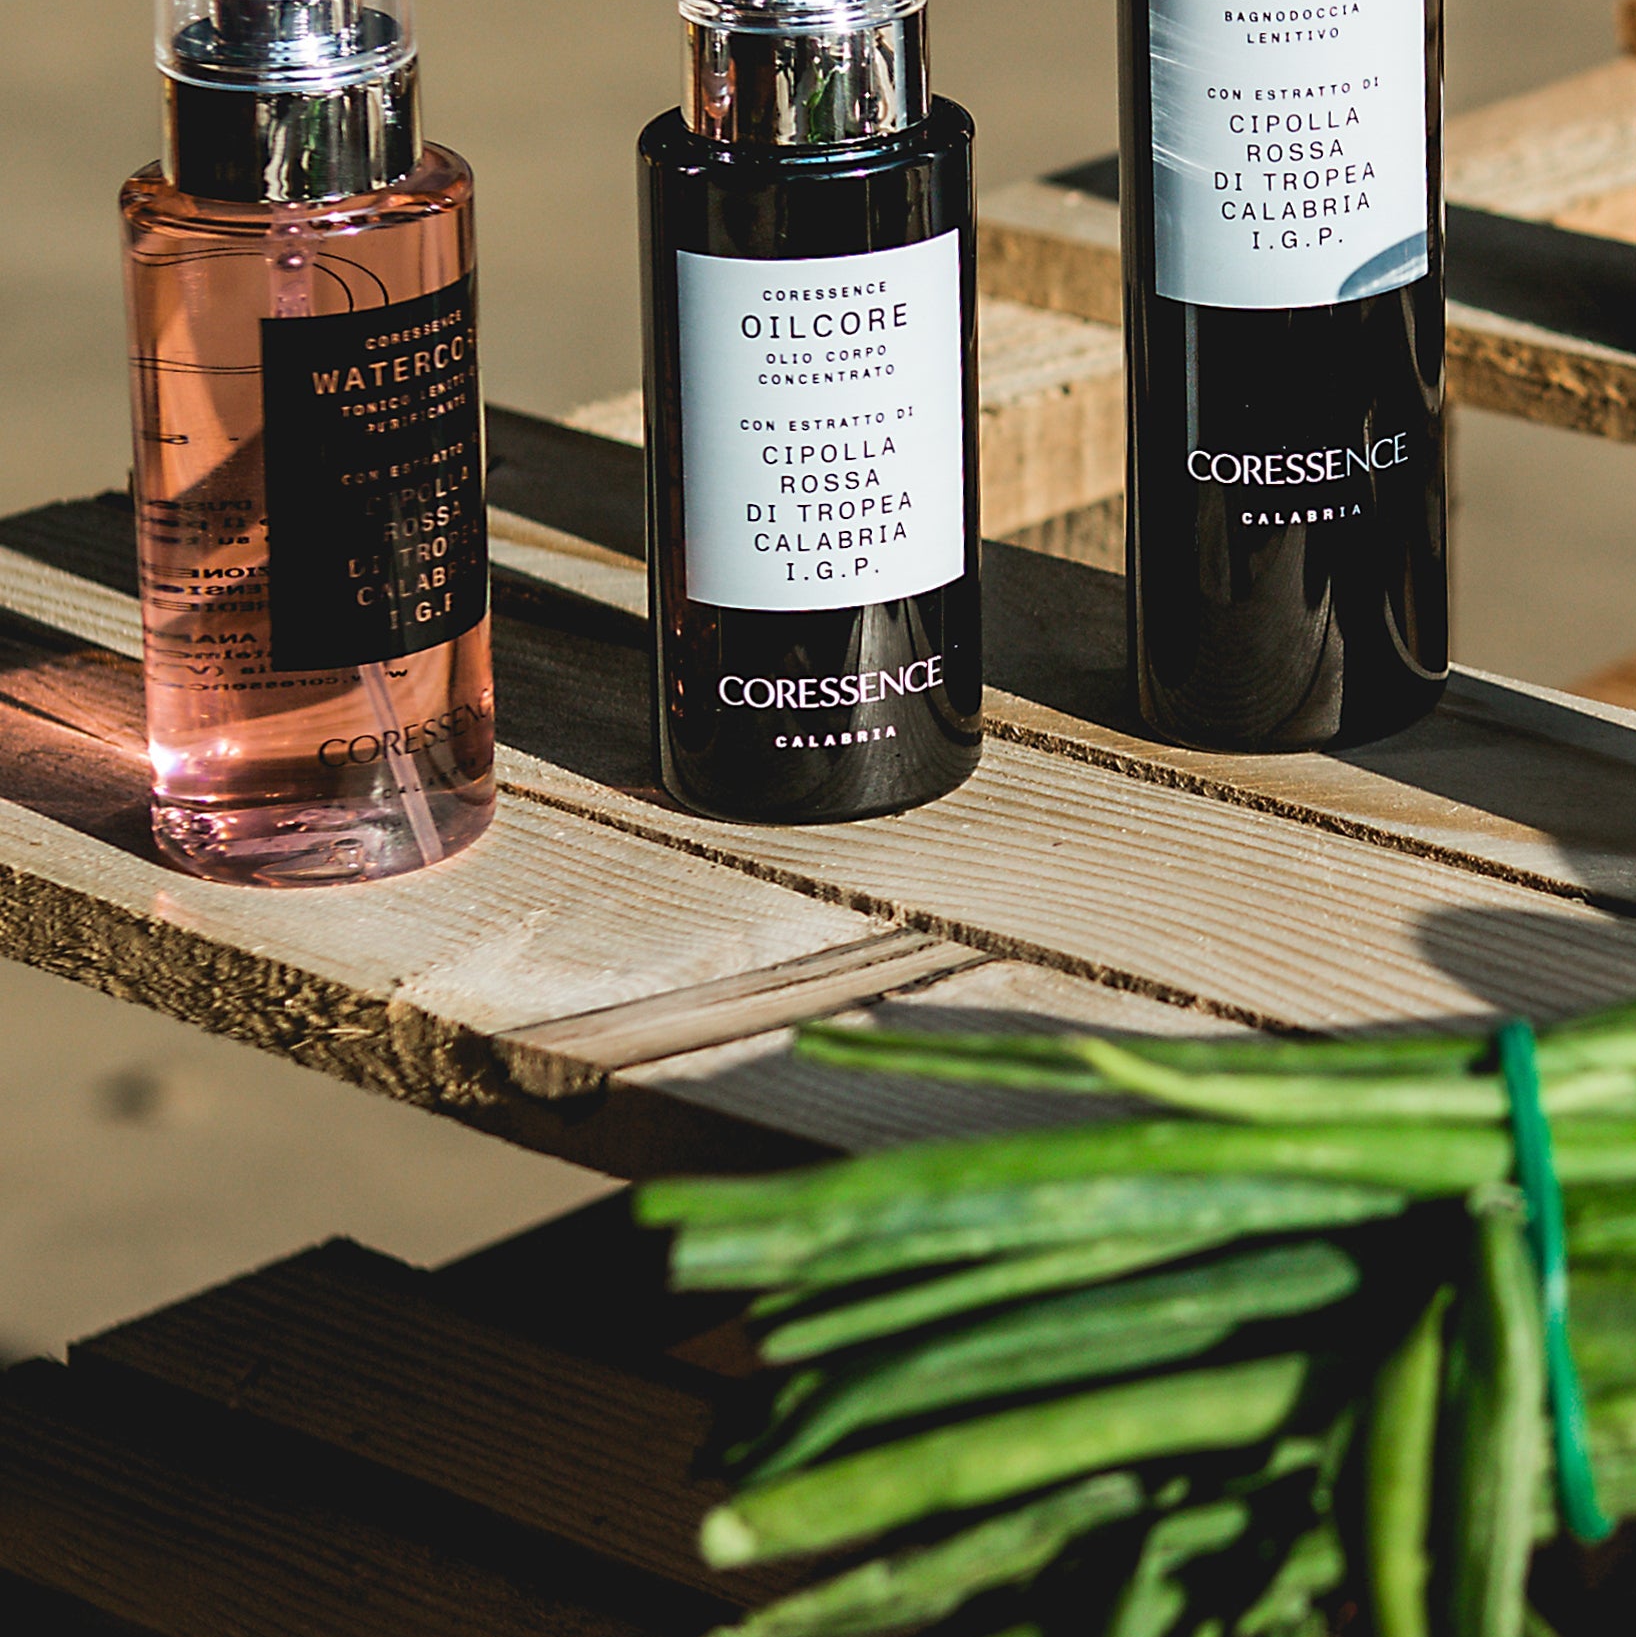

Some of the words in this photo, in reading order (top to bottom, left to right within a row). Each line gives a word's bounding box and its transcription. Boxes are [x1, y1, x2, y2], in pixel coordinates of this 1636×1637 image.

[1224, 3, 1360, 23] BAGNODOCCIA
[1247, 27, 1340, 45] LENITIVO
[1207, 87, 1242, 101] CON
[1255, 81, 1352, 101] ESTRATTO
[1363, 76, 1380, 90] DI
[1229, 107, 1360, 134] CIPOLLA
[1247, 139, 1344, 163] ROSSA
[1214, 172, 1243, 192] DI
[1263, 162, 1376, 192] TROPEA
[1221, 192, 1370, 221] CALABRIA
[1252, 227, 1344, 250] I.G.P.
[762, 281, 888, 302] CORESSENCE
[365, 309, 463, 350] CORESSENCE
[741, 302, 908, 340] OILCORE
[766, 352, 813, 365] OLIO
[826, 344, 888, 363] CORPO
[758, 364, 896, 386] CONCENTRATO
[341, 395, 411, 418] TONICO
[740, 418, 776, 432] CON
[788, 412, 886, 432] ESTRATTO
[896, 406, 914, 420] DI
[762, 436, 896, 465] CIPOLLA
[1187, 431, 1409, 485] CORESSENCE
[341, 469, 380, 486] CON
[781, 468, 881, 494] ROSSA
[747, 503, 777, 523] DI
[797, 491, 912, 522] TROPEA
[1241, 503, 1361, 525] CALABRIA
[754, 521, 908, 552] CALABRIA
[786, 557, 880, 581] I.G.P.
[718, 655, 944, 709] CORESSENCE
[774, 725, 897, 749] CALABRIA
